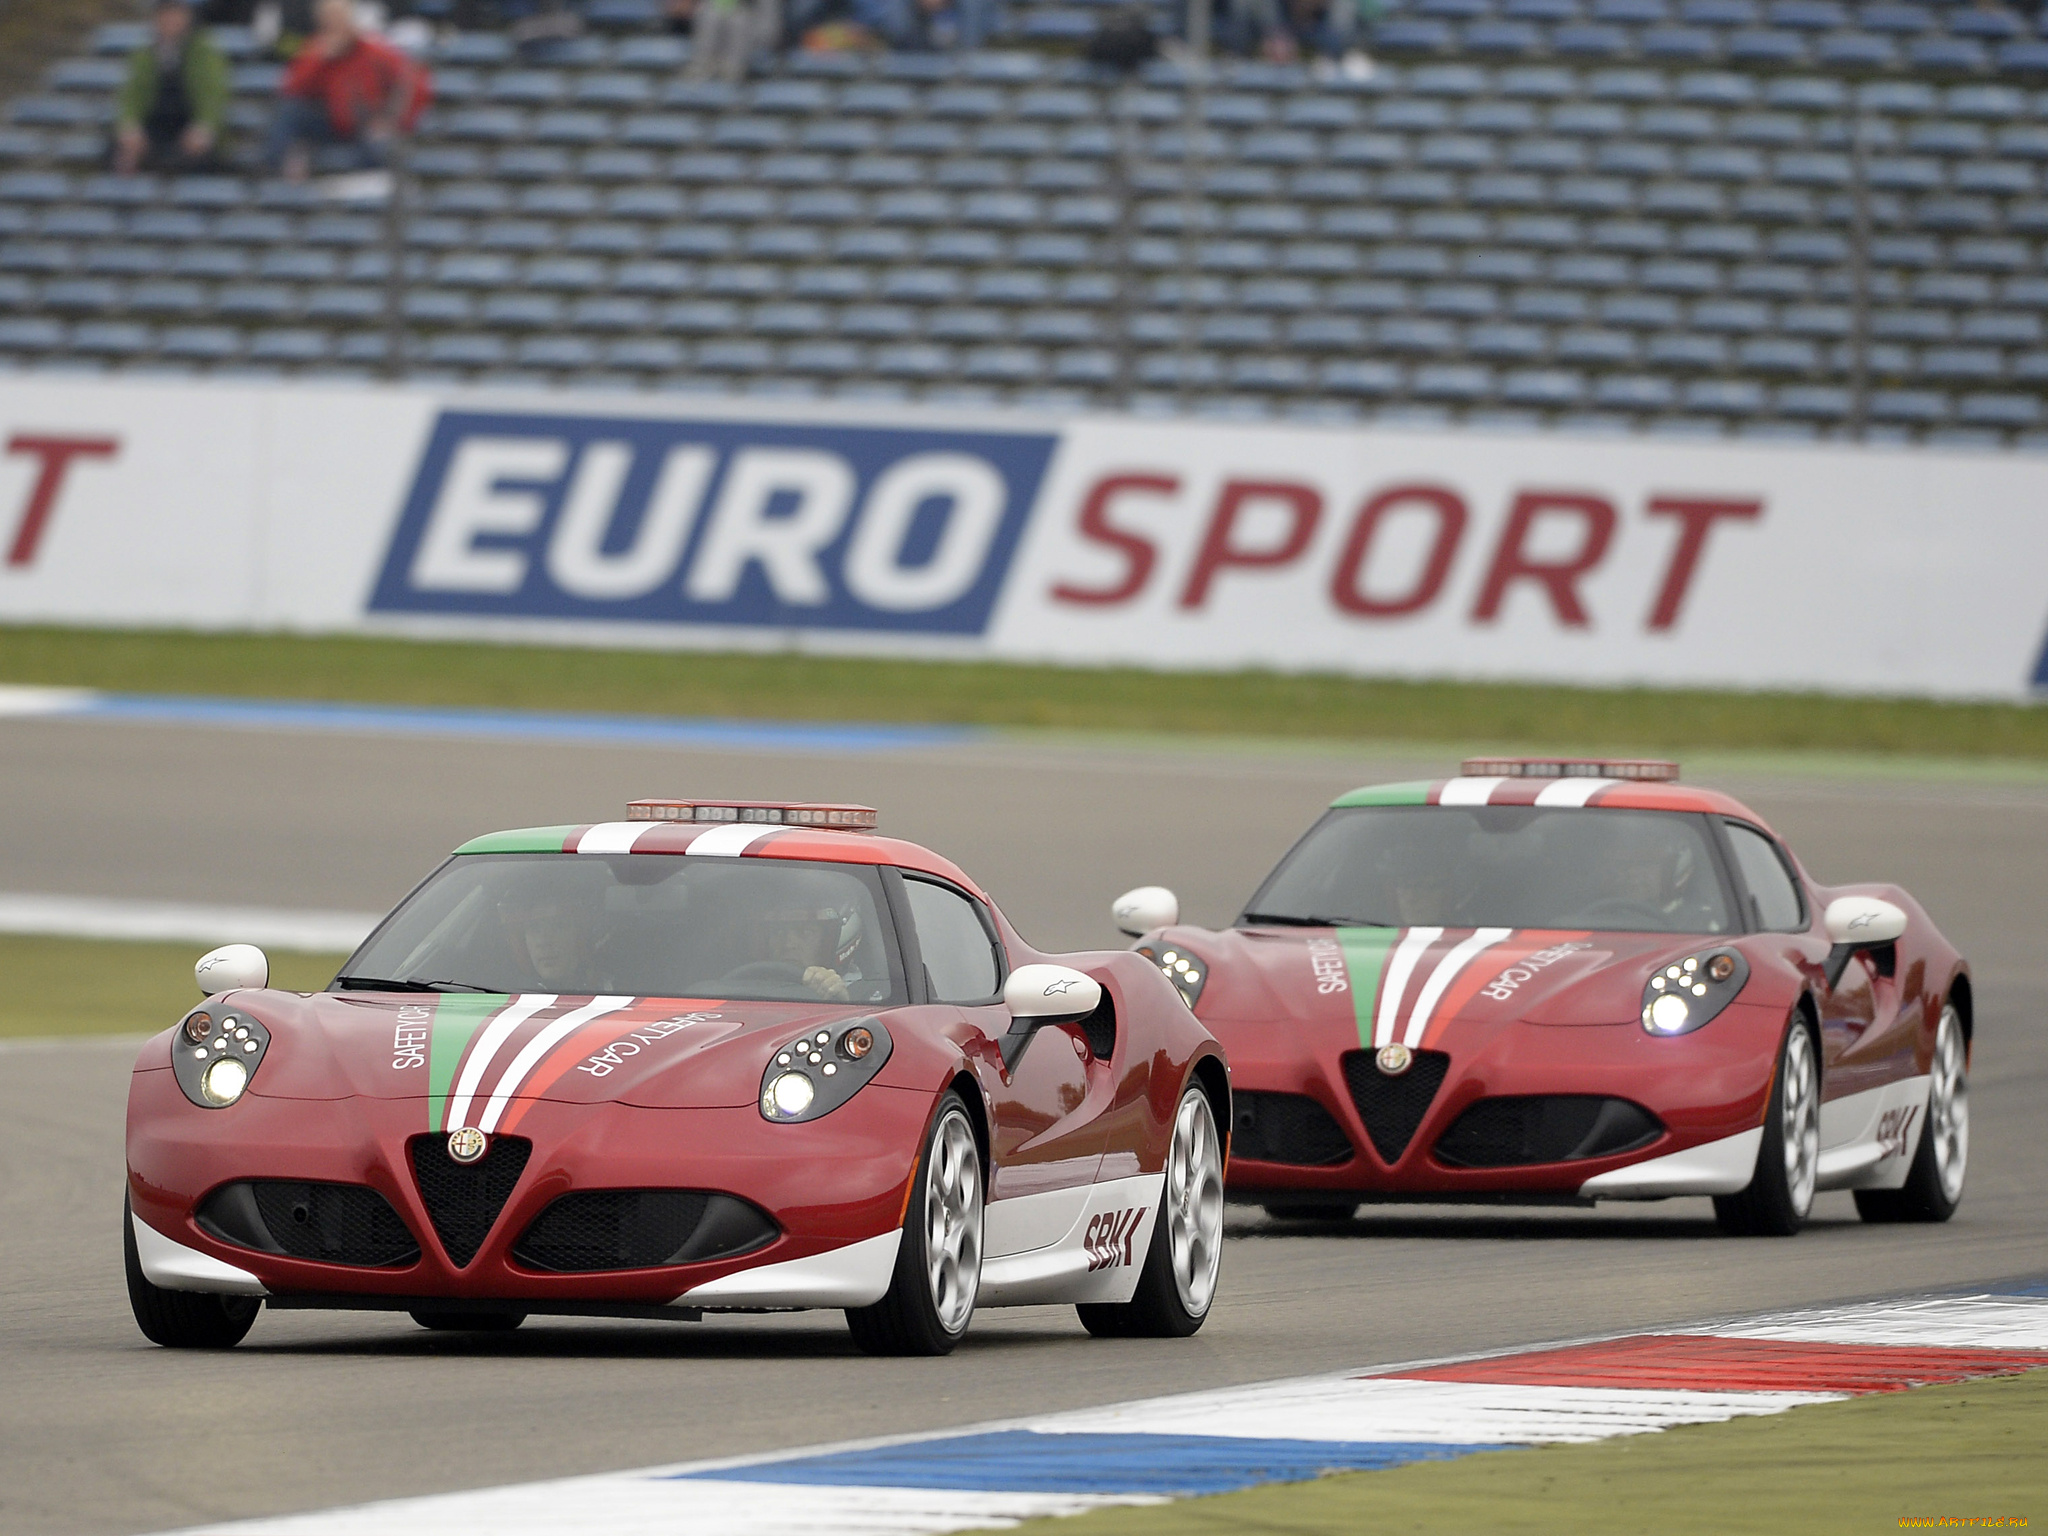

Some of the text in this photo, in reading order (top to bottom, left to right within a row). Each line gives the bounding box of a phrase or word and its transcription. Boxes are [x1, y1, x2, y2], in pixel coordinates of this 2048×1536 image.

[1481, 967, 1532, 1000] CAR
[392, 1020, 428, 1070] SAFETY
[577, 1011, 722, 1077] SAFETY CAR
